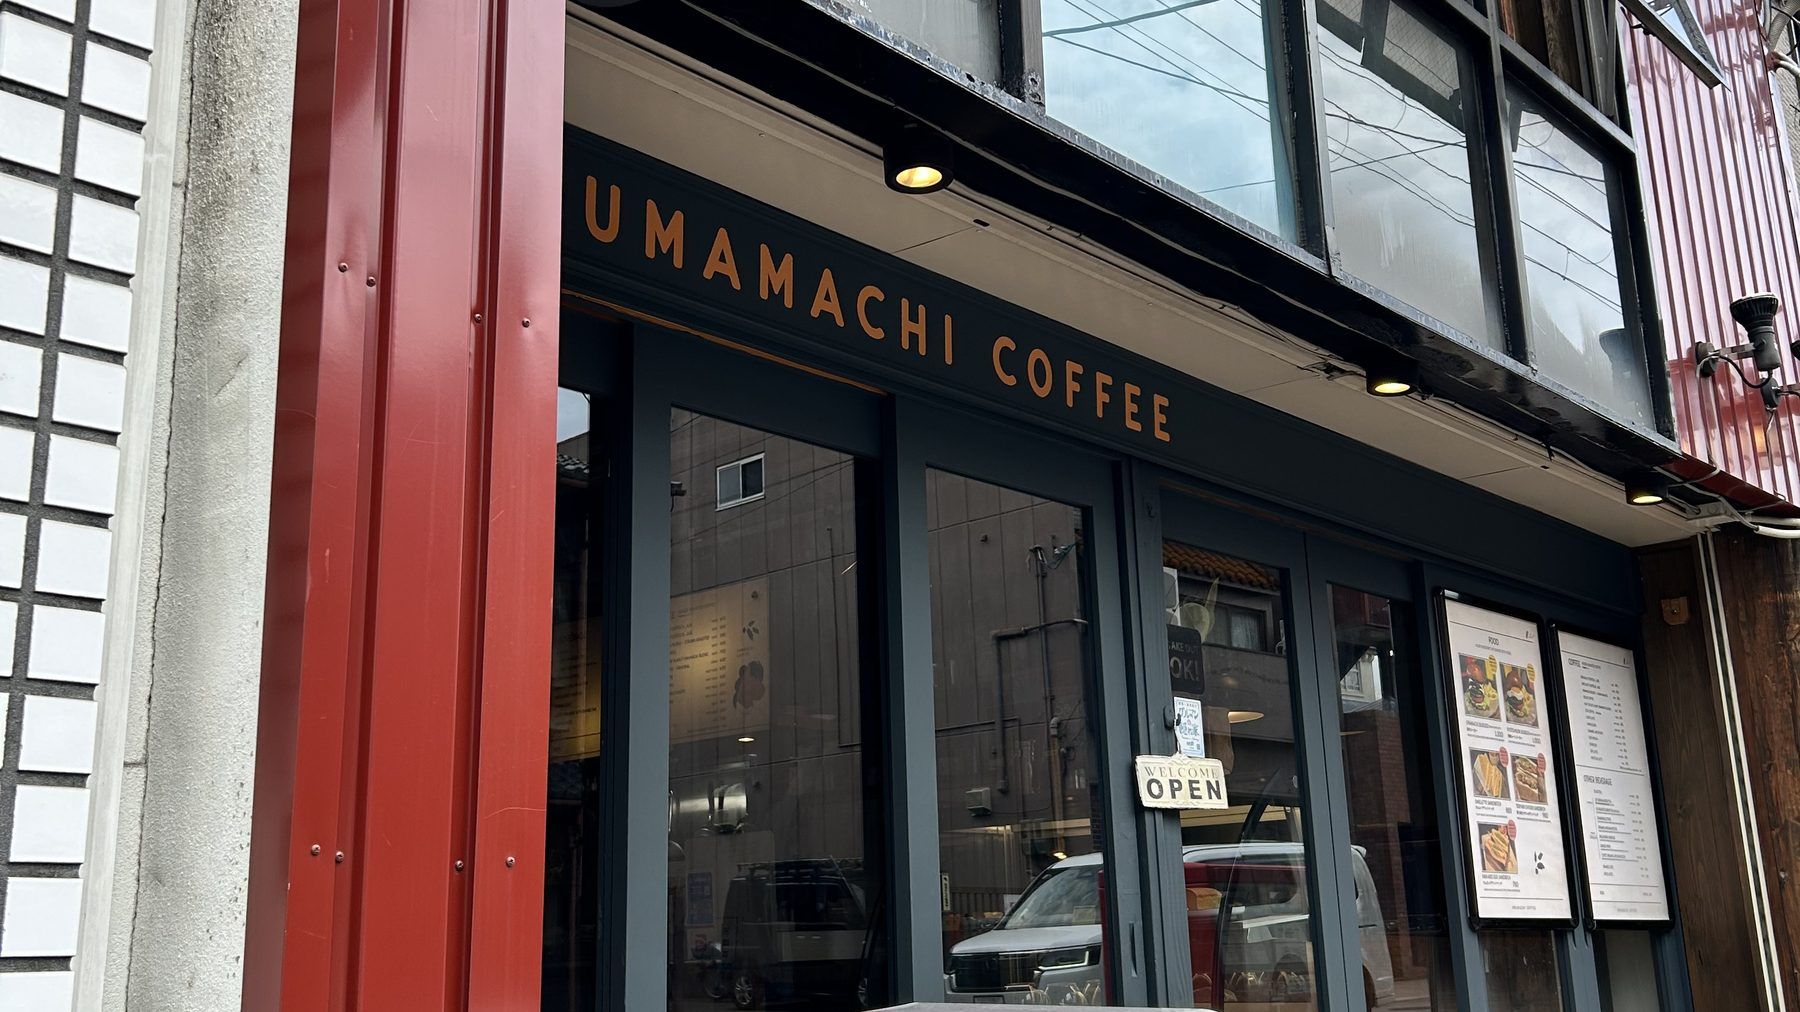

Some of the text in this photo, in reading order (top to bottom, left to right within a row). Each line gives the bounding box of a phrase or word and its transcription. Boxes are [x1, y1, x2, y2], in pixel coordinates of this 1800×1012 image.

[585, 174, 1171, 442] UMAMACHI COFFEE
[1170, 656, 1200, 681] OK!
[1144, 765, 1220, 779] WELCOME
[1146, 778, 1222, 800] OPEN
